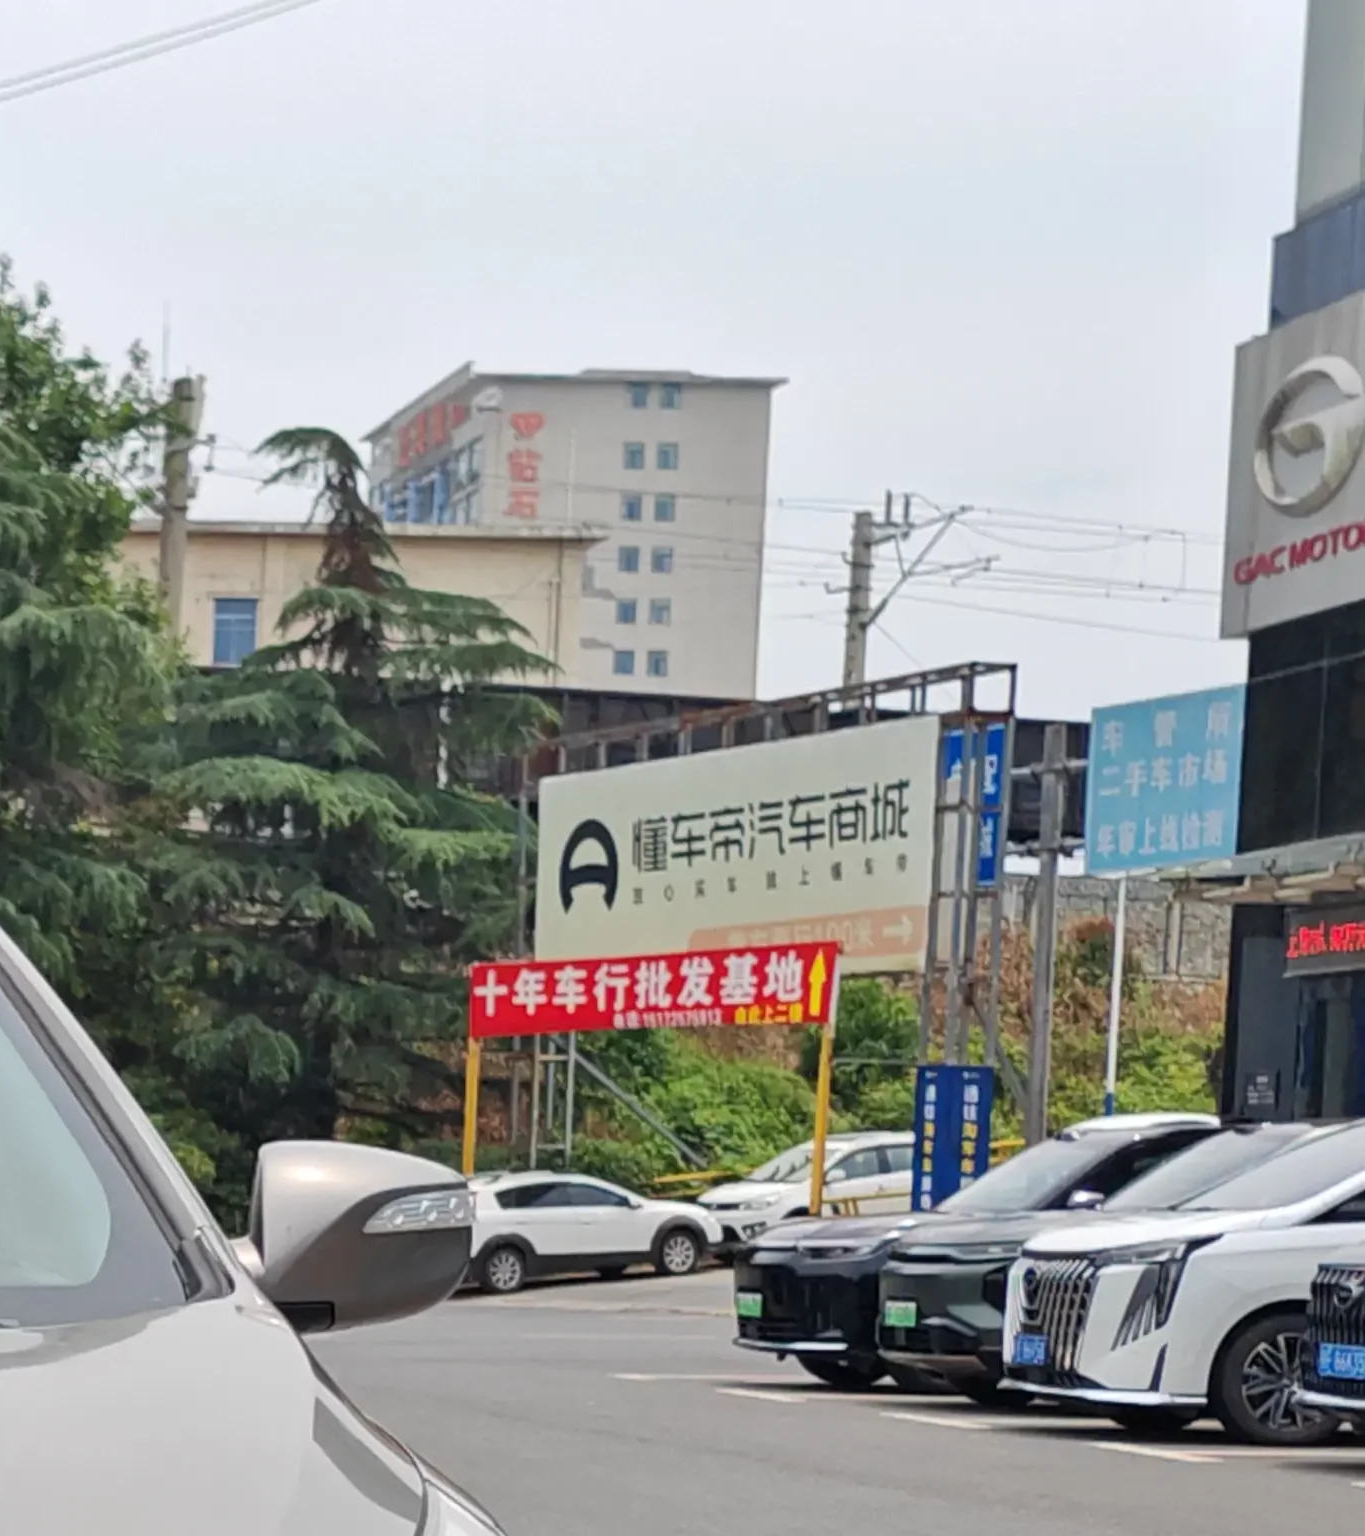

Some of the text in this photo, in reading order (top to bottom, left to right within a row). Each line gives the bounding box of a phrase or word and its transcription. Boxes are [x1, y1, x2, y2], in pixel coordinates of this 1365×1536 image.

[1233, 520, 1365, 585] GAC MOTO
[1098, 748, 1227, 798] 二手车市场
[631, 778, 910, 874] 懂车帝汽车商城
[473, 951, 805, 1018] 十年车行批发基地
